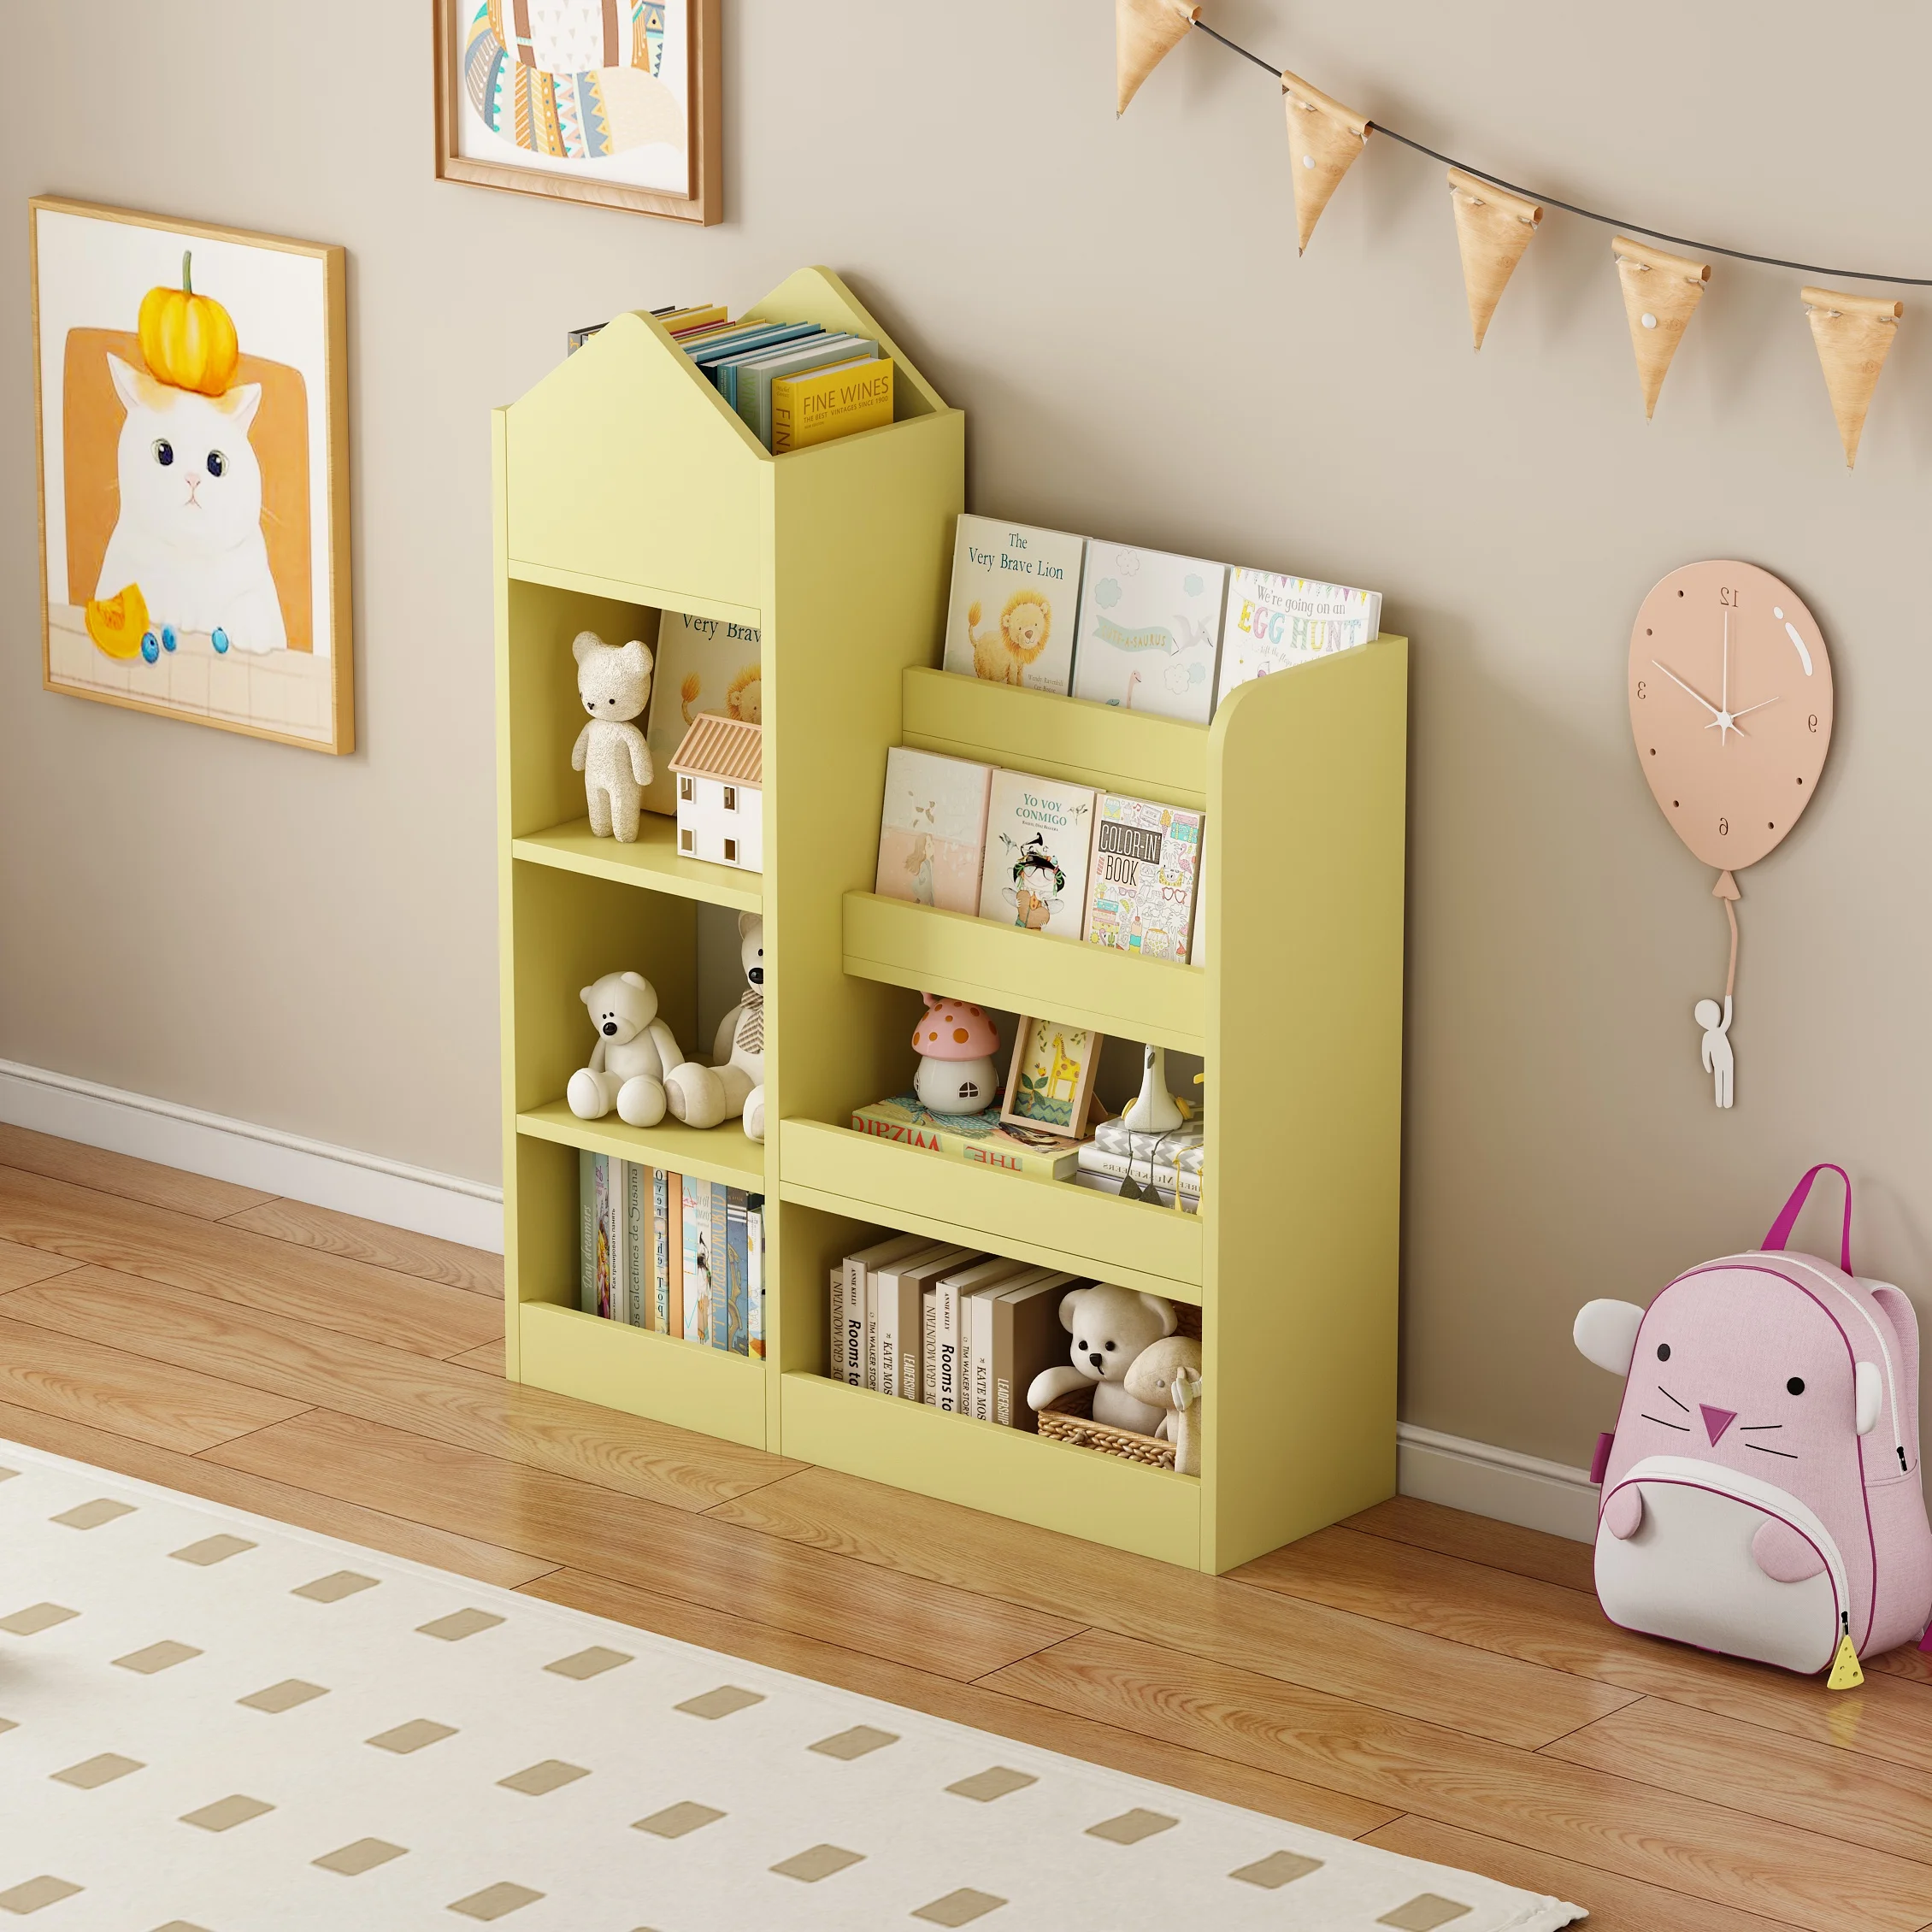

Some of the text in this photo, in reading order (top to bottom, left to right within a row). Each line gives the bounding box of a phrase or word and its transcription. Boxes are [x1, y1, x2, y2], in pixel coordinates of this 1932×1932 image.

[804, 376, 889, 415] FINE WINES
[815, 411, 828, 420] BEST
[830, 403, 857, 415] VINTAGES
[858, 399, 874, 409] SINCE
[875, 395, 888, 404] 1900
[1009, 533, 1028, 549] The
[969, 547, 1063, 580] Very Brave Lion
[1258, 585, 1346, 616] We're going on an
[683, 613, 718, 640] Very
[1237, 598, 1362, 652] EGG HUNT
[1016, 807, 1067, 826] CONMIGO
[1105, 855, 1139, 886] BOOK
[965, 1146, 1022, 1172] THE
[628, 1169, 640, 1222] Susana
[581, 1205, 597, 1288] Day dreamers
[628, 1225, 639, 1241] de
[833, 1281, 843, 1334] MOUNTAIN
[926, 1305, 936, 1359] MOUNTAIN
[833, 1334, 843, 1364] GRAY
[848, 1319, 861, 1386] Rooms to
[883, 1340, 892, 1369] KATE
[903, 1353, 915, 1400] LEADERSHIP
[926, 1358, 936, 1387] GRAY
[941, 1344, 954, 1411] Rooms to
[977, 1366, 986, 1395] KATE
[997, 1377, 1009, 1426] LEADERSHIP
